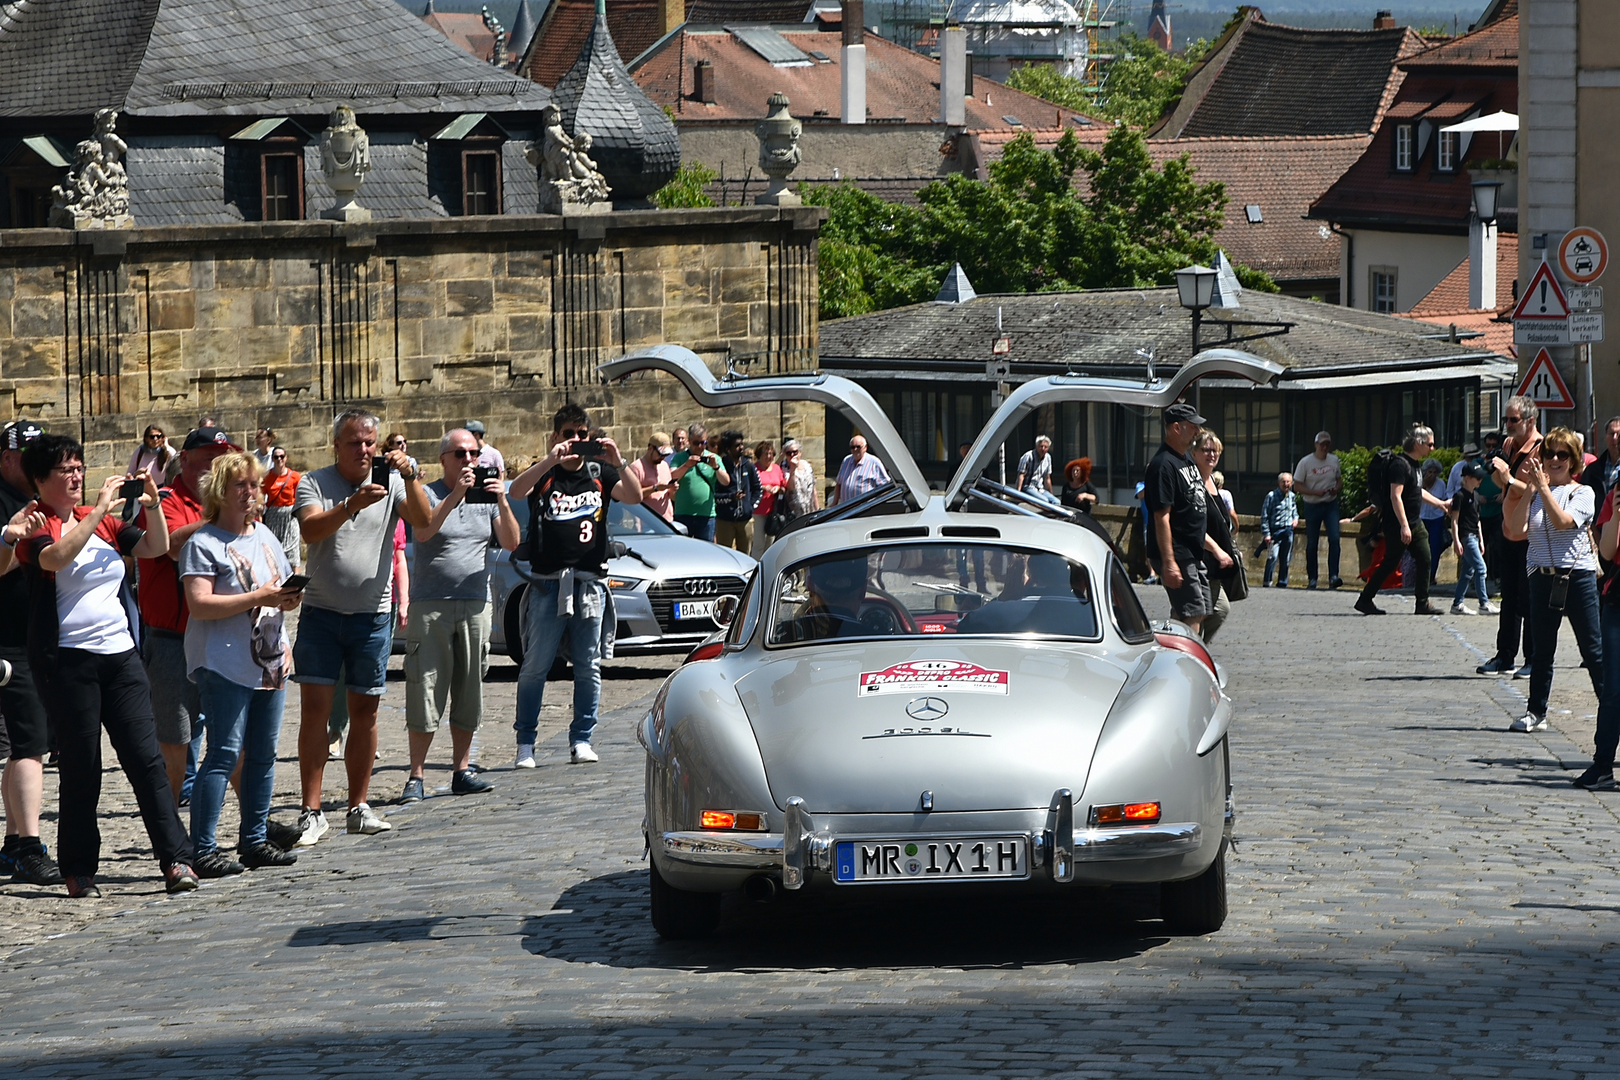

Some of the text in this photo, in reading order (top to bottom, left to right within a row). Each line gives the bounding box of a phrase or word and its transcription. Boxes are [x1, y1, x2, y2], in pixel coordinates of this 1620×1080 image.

[1577, 299, 1592, 307] frei
[1572, 315, 1599, 324] Linien-
[1516, 321, 1568, 331] Durchfahrtsbeschränkun
[1571, 324, 1600, 332] verkehr
[1579, 332, 1592, 340] frei
[579, 520, 593, 543] 3
[681, 604, 696, 616] BA
[866, 673, 1000, 684] FRANKEN CLASSIC
[862, 844, 902, 875] MR
[842, 865, 850, 874] D
